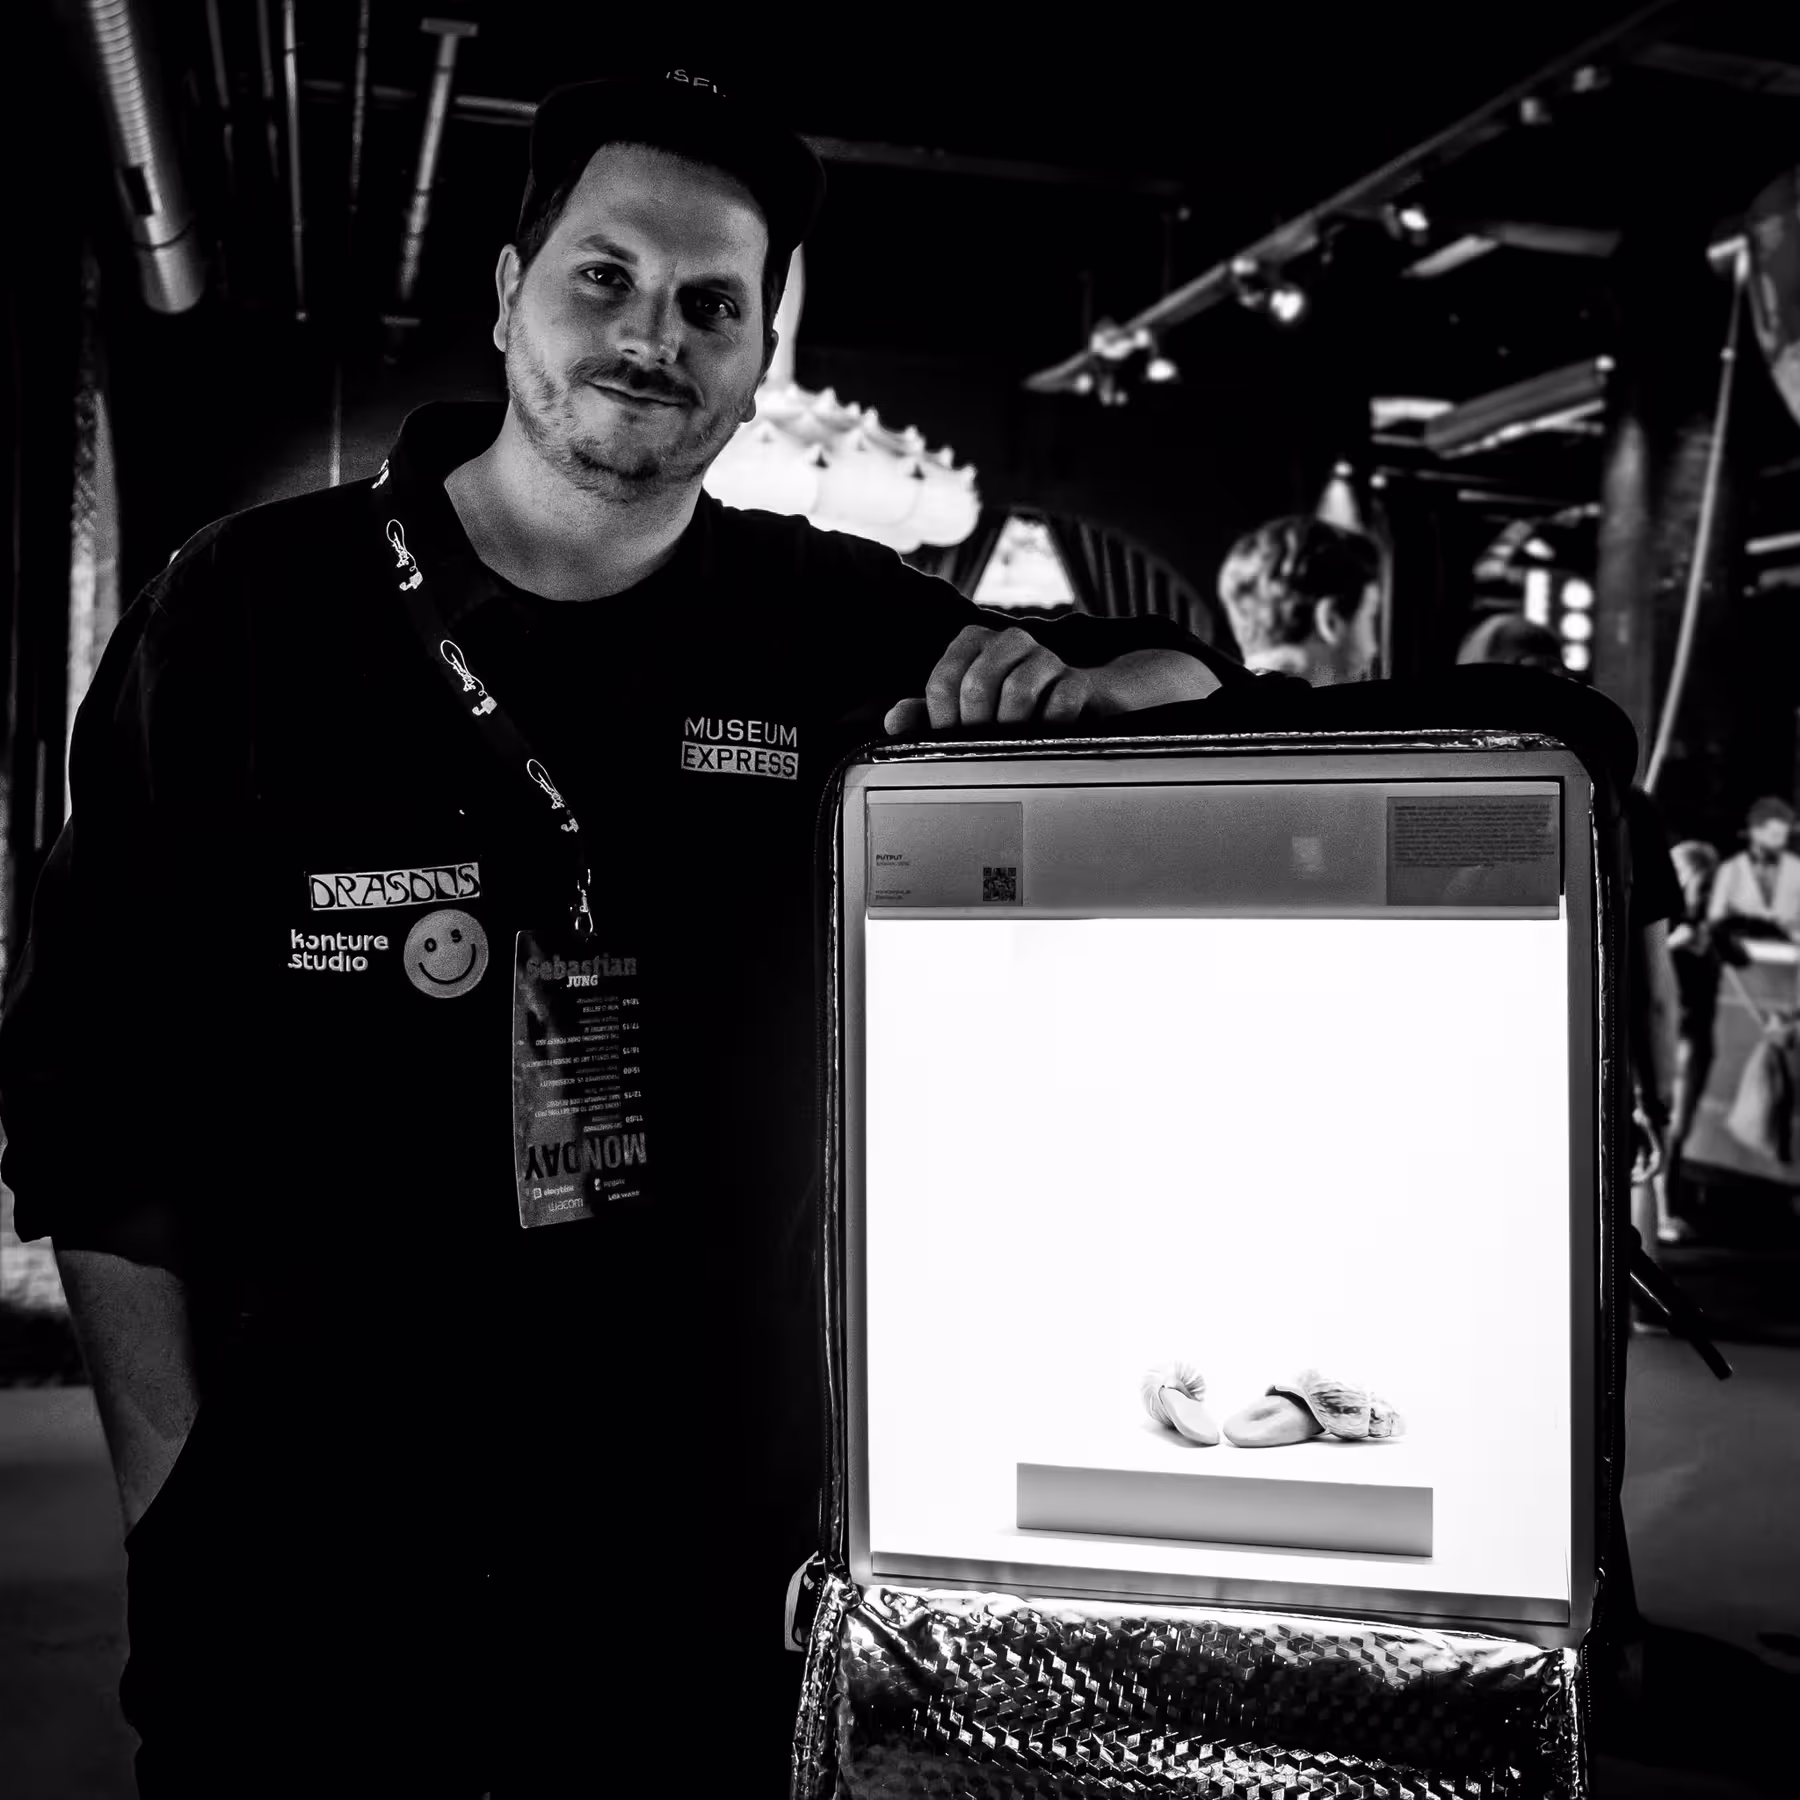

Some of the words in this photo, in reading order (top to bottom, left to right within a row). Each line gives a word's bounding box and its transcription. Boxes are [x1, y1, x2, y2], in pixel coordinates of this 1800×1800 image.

[683, 716, 798, 748] MUSEUM
[683, 744, 796, 777] EXPRESS
[287, 951, 369, 973] studio
[525, 952, 638, 980] Sebastian
[566, 974, 600, 988] JUNG
[524, 1131, 648, 1181] MONDAY
[548, 1197, 584, 1212] wacom
